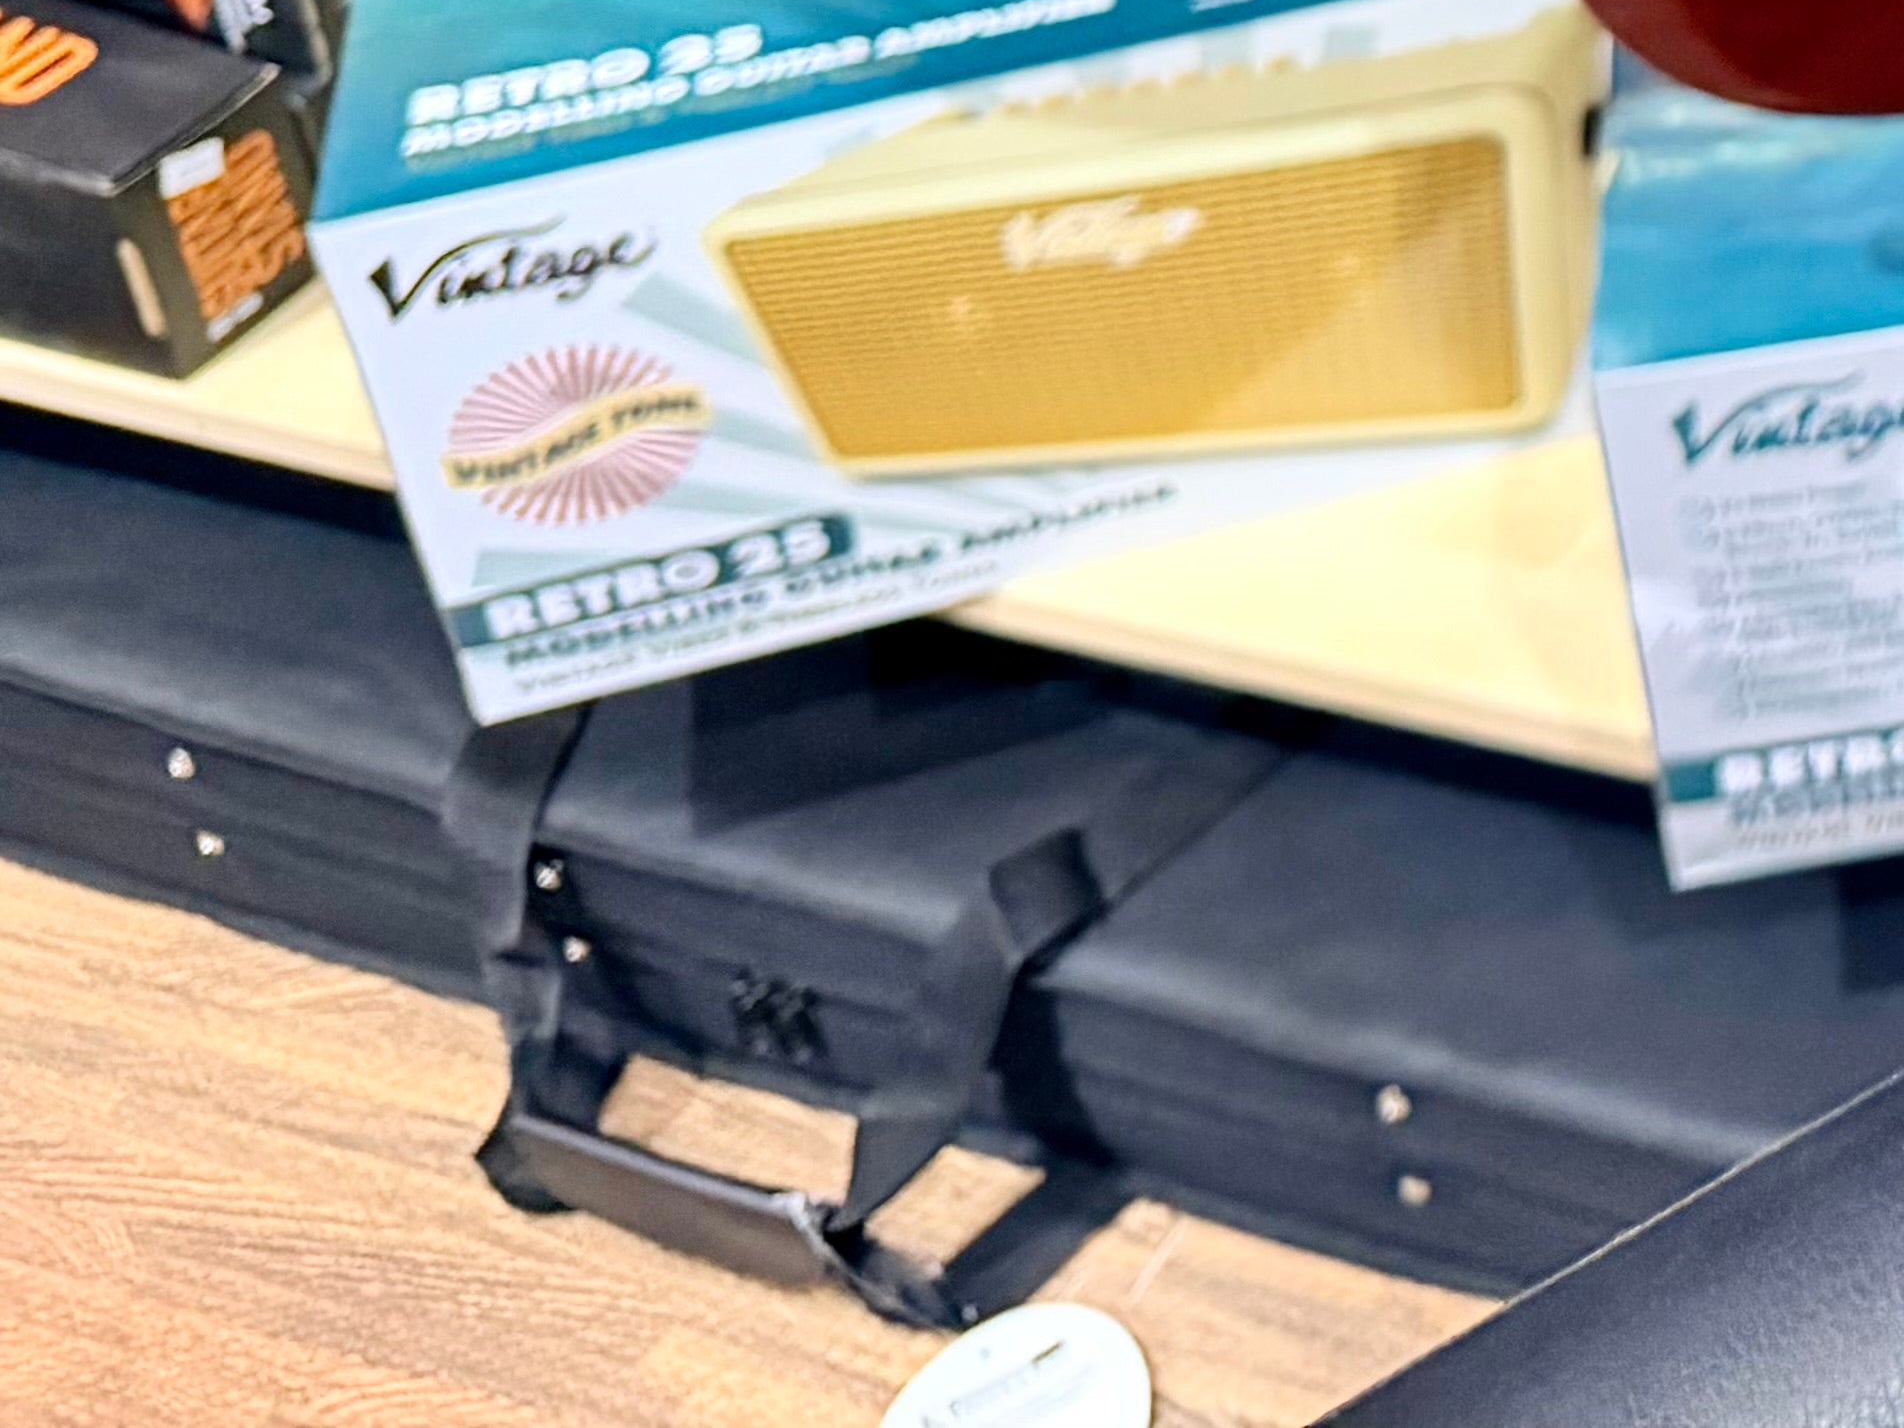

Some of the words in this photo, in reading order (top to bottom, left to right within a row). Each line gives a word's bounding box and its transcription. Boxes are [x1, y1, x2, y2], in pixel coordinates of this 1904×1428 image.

[370, 216, 658, 323] Vintage
[481, 546, 722, 640] RETRO
[728, 521, 833, 584] 25
